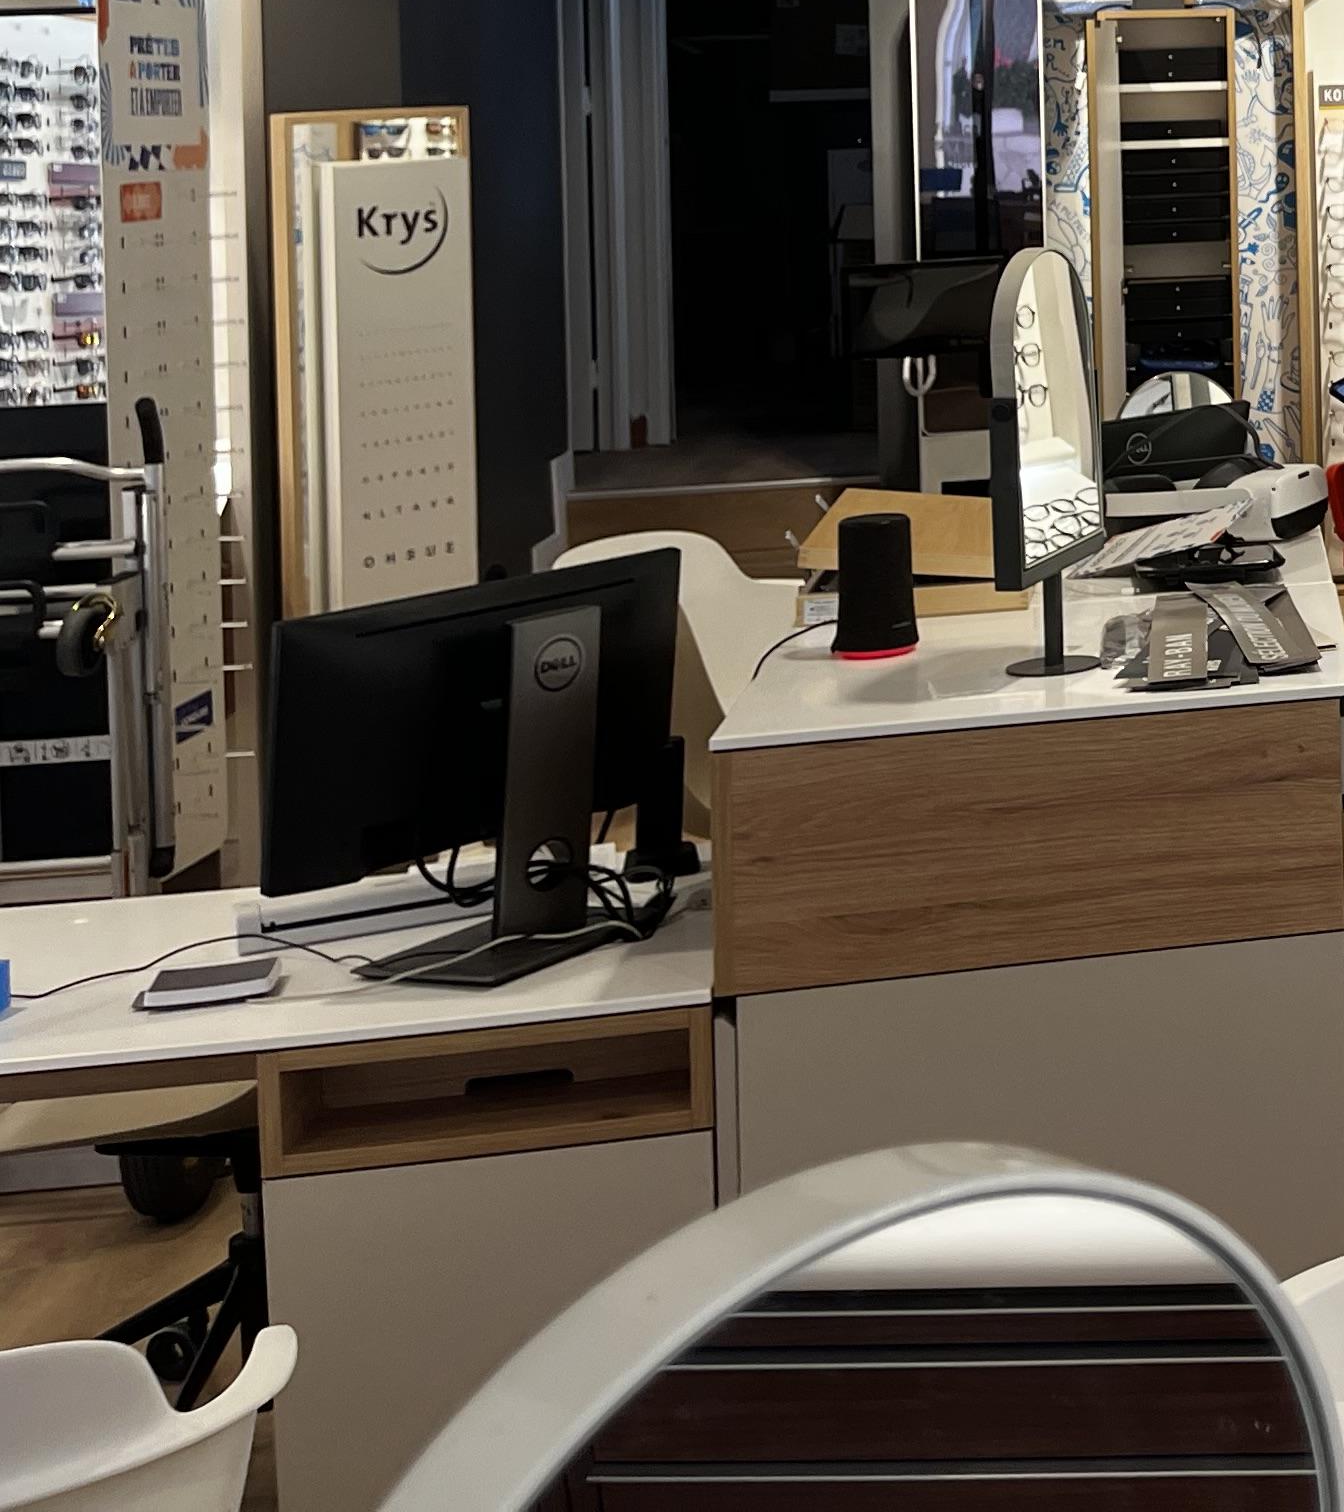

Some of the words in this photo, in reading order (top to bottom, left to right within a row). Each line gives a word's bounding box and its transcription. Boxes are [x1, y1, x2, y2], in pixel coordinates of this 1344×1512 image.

[138, 62, 181, 81] PORTER
[358, 205, 438, 245] Krys
[541, 655, 577, 674] DELL
[1163, 633, 1193, 678] RAY-BAN
